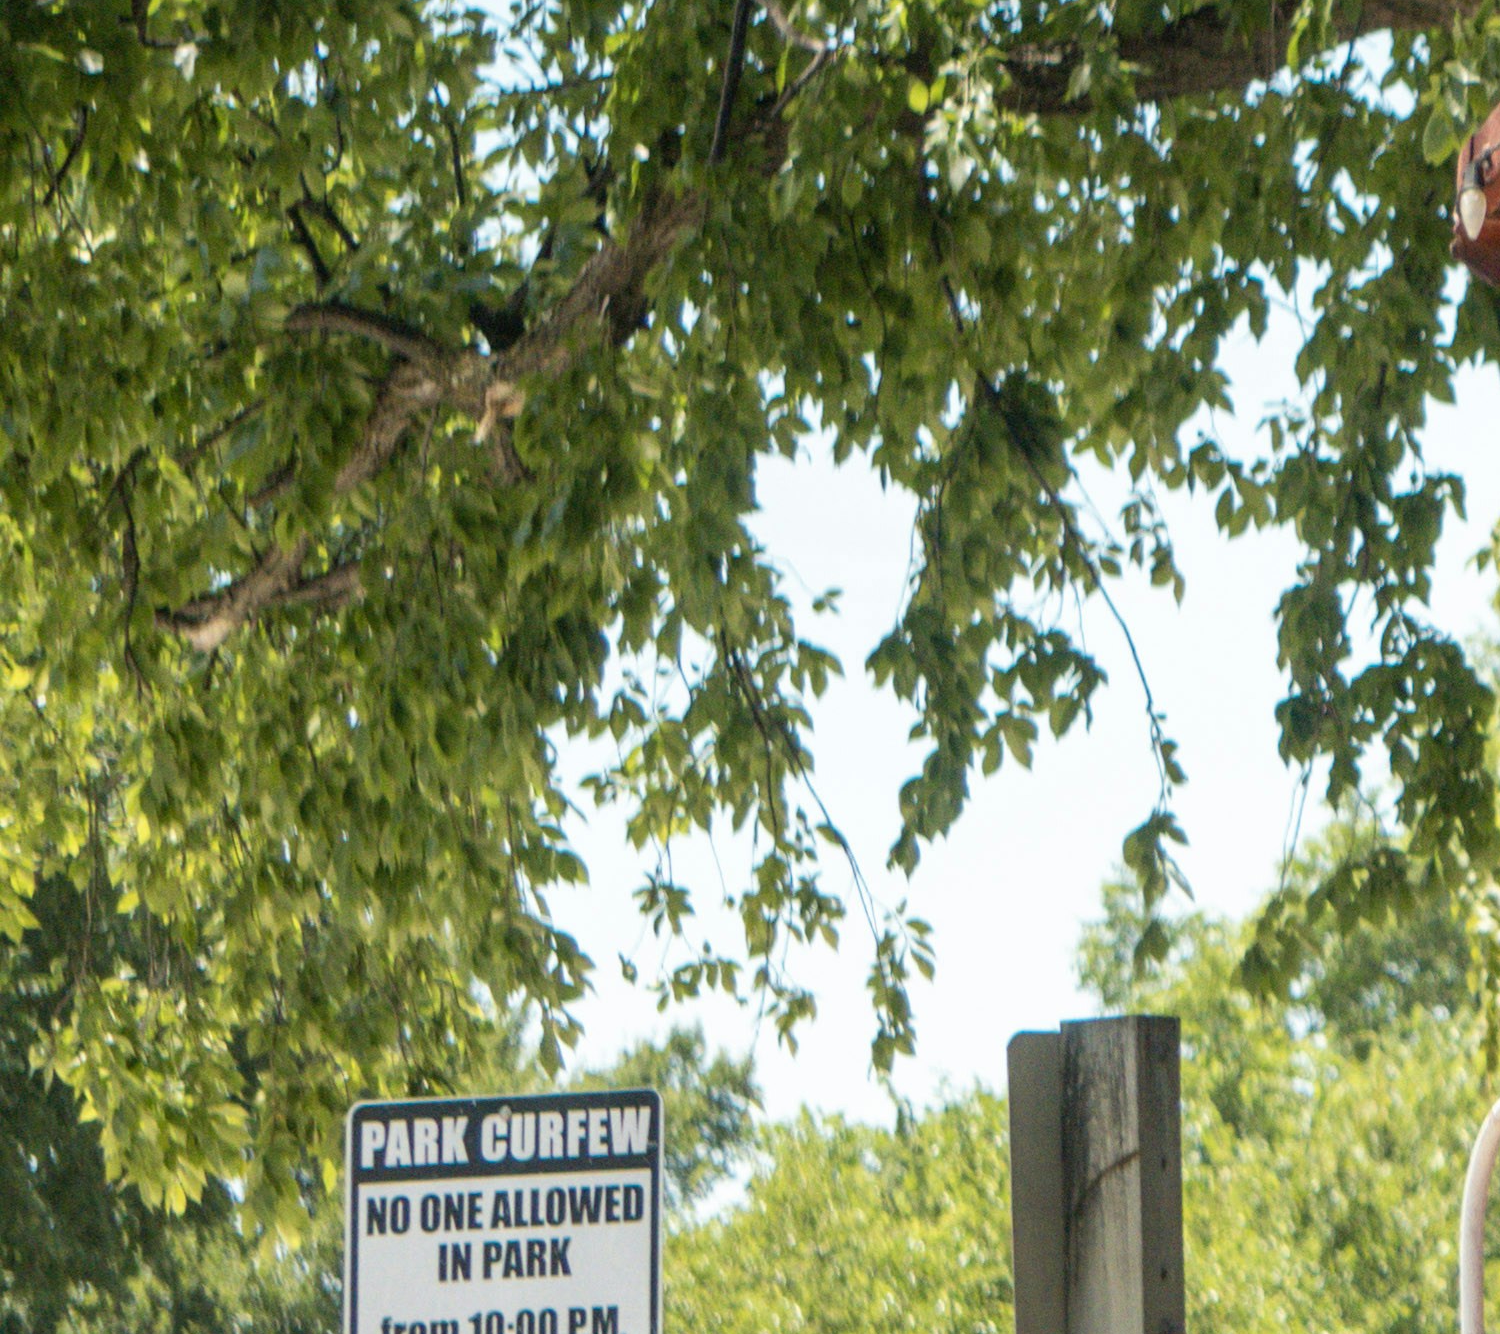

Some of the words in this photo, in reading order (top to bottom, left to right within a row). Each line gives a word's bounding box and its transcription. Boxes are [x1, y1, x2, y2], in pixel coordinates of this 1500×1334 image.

[360, 1117, 469, 1169] PARK
[480, 1106, 651, 1163] CURFEW
[366, 1196, 410, 1236] NO
[420, 1192, 483, 1233] ONE
[491, 1184, 644, 1229] ALLOWED
[438, 1242, 472, 1282] IN
[483, 1237, 572, 1280] PARK
